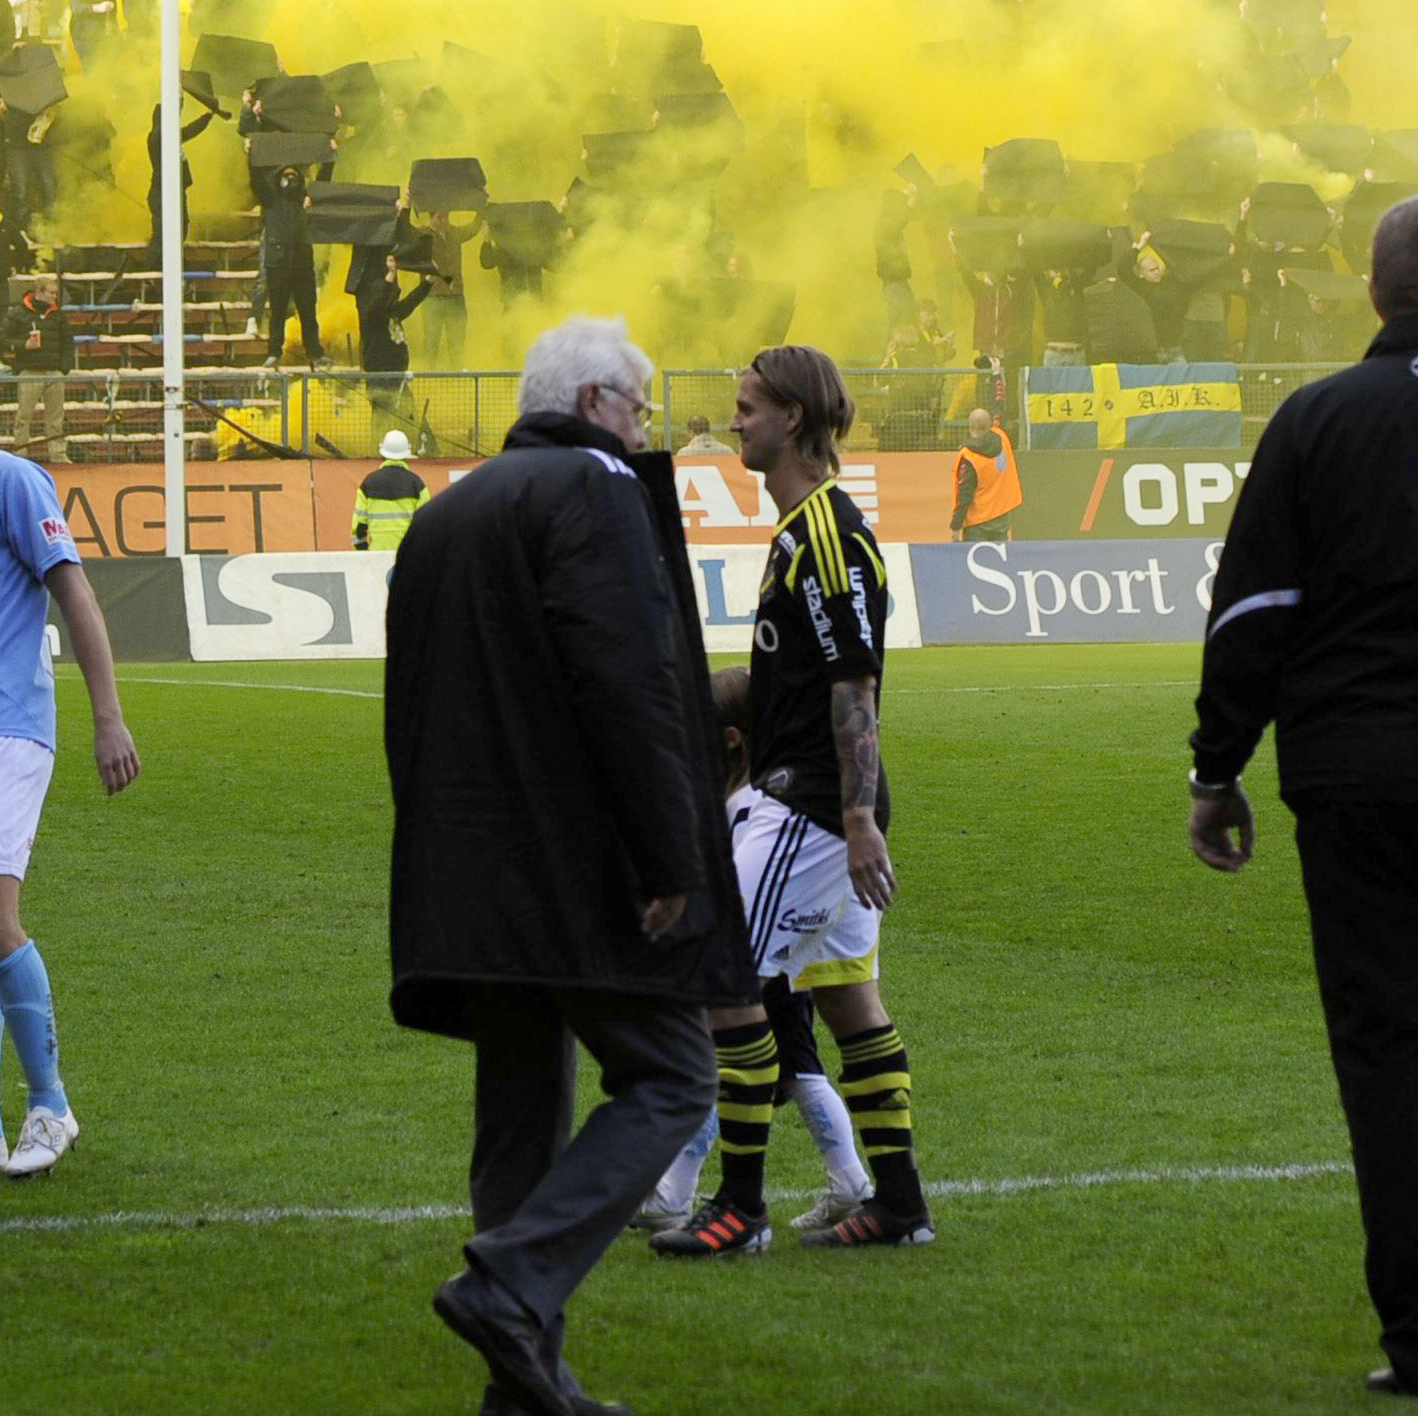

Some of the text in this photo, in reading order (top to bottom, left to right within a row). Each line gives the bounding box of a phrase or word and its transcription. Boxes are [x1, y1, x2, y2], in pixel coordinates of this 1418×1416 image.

[57, 483, 284, 558] AGET
[802, 575, 840, 663] stadium
[965, 540, 1176, 637] Sport
